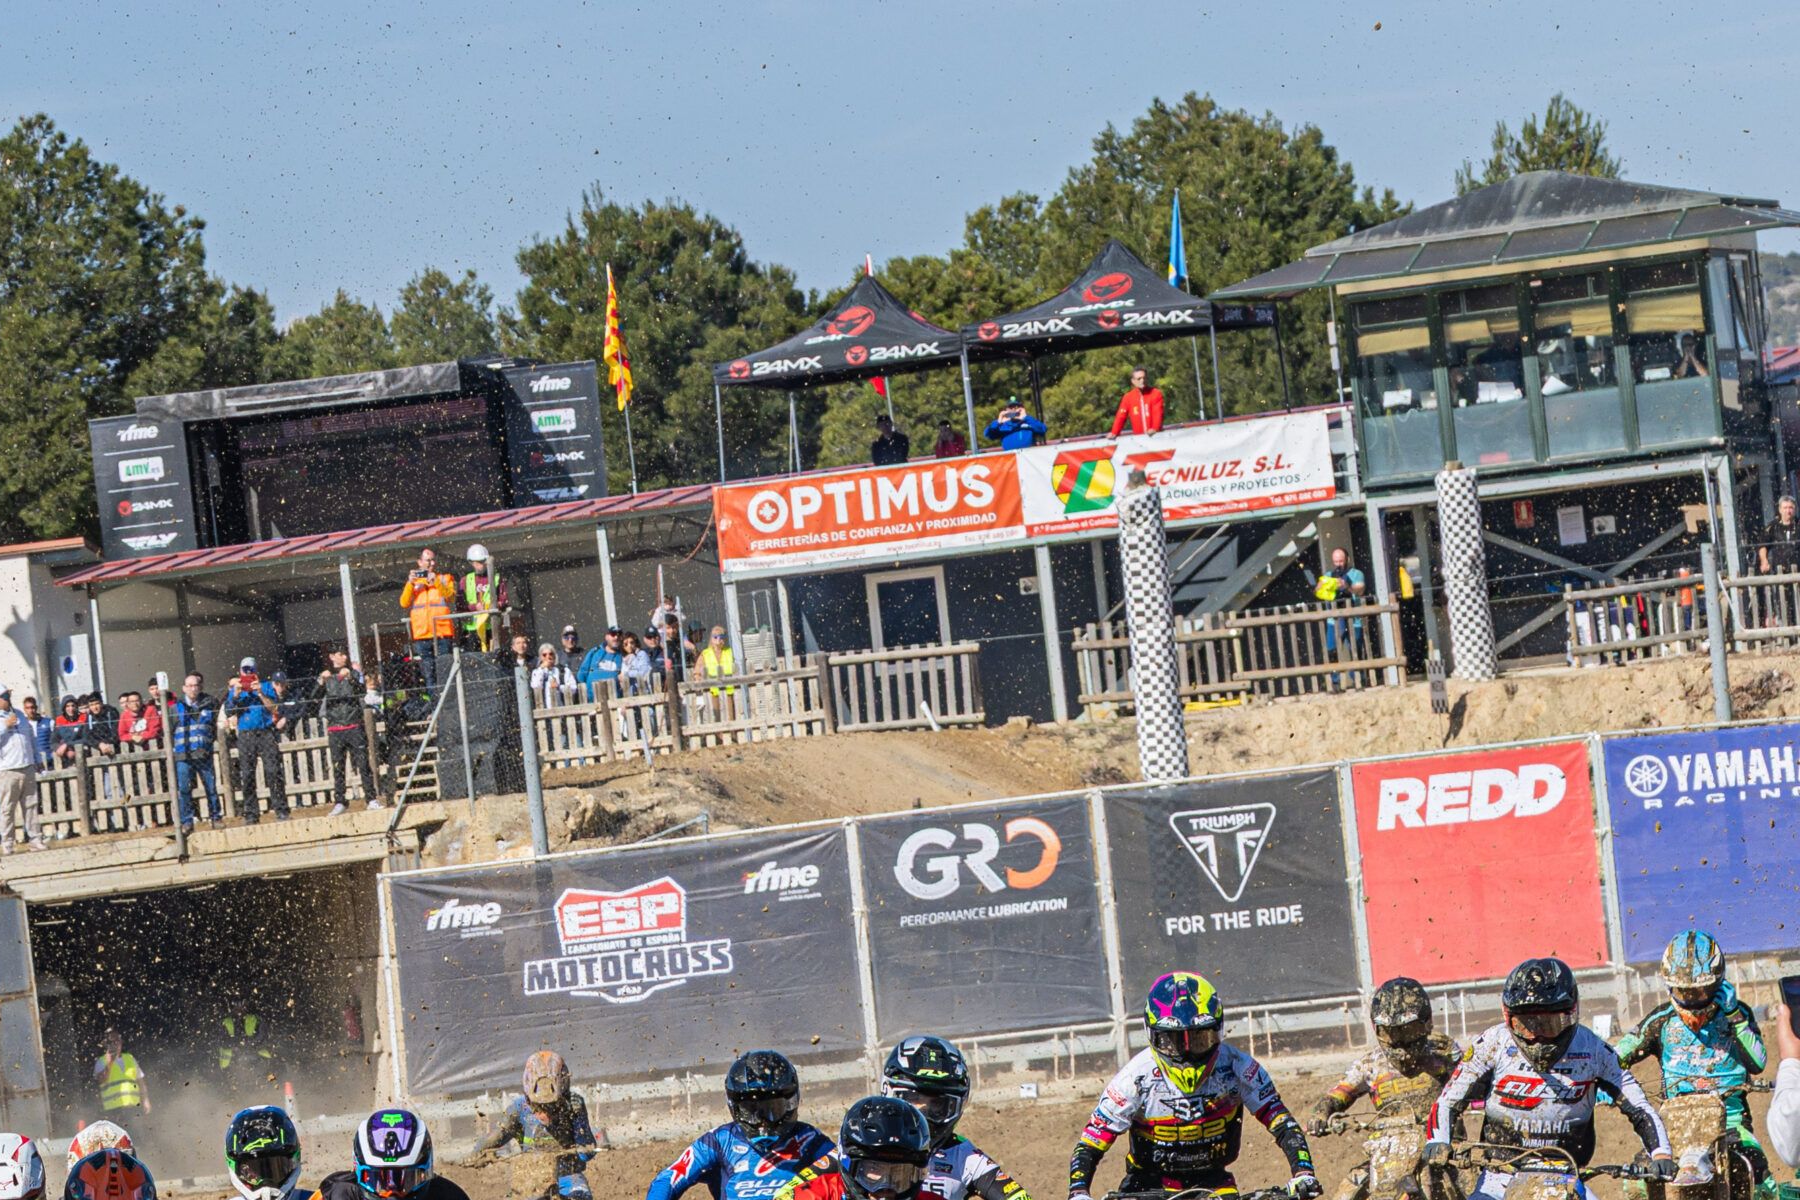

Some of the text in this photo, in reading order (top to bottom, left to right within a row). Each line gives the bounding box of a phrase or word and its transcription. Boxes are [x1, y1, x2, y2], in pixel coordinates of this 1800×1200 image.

[1002, 317, 1074, 338] 24MX
[1123, 309, 1195, 327] 24MX
[752, 356, 822, 375] 24MX
[869, 342, 940, 360] 24MX
[1253, 453, 1292, 474] S.L.
[747, 464, 995, 533] OPTIMUS
[1221, 474, 1301, 494] Y PROYECTOS
[750, 512, 997, 551] FERRETERÍAS DE CONFIANZA Y PROXIMIDAD
[1669, 747, 1800, 790] YAMAH
[1377, 763, 1566, 831] REDD
[1189, 811, 1255, 831] TRIUMPH
[743, 861, 820, 894] rfme
[426, 899, 502, 932] rfme
[563, 893, 679, 937] ESP
[900, 897, 1068, 928] PERFORMANCE LUBRICATION
[1166, 904, 1303, 937] FOR THE RIDE
[527, 942, 731, 993] MOTOCROSS
[916, 1068, 949, 1079] FLY
[1513, 1118, 1571, 1134] YAMAHA
